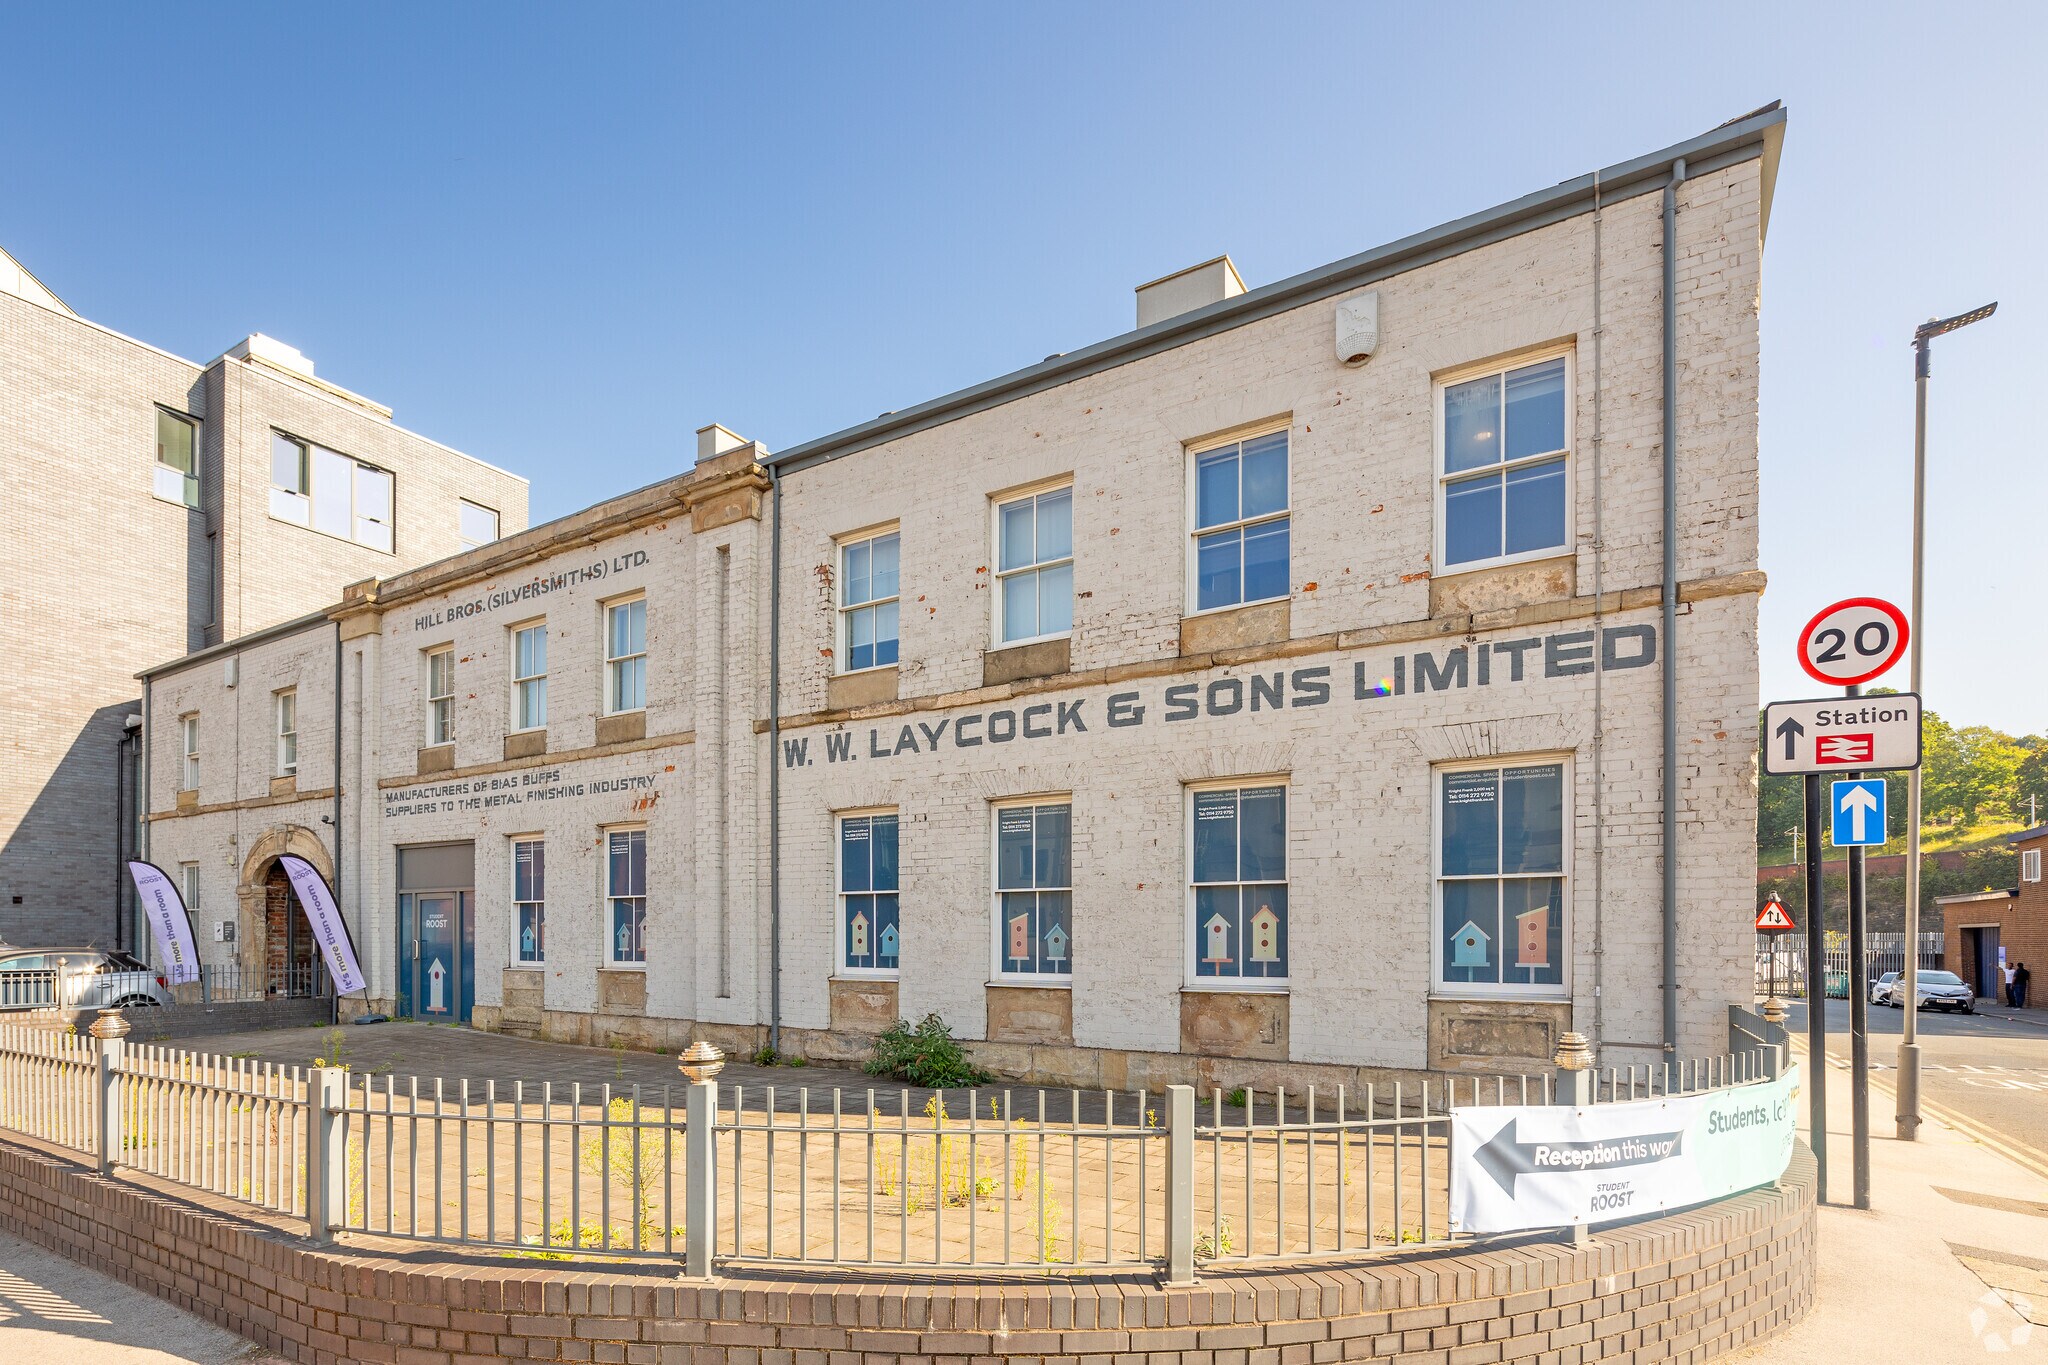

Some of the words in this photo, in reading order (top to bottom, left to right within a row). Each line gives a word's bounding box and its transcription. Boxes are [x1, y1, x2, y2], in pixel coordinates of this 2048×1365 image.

[415, 613, 443, 631] HILL
[447, 599, 485, 622] BROS.
[488, 560, 608, 611] (SILVERSMITHS)
[613, 550, 650, 573] LTD.
[1814, 621, 1890, 664] 20
[783, 737, 813, 767] W.
[826, 732, 857, 762] W.
[870, 699, 1088, 758] LAYCOCK
[1107, 691, 1145, 728] &
[1165, 666, 1330, 721] SONS
[1354, 624, 1656, 700] LIMITED
[1815, 706, 1908, 727] Station
[386, 783, 469, 803] MANUFACTURERS
[473, 781, 487, 791] OF
[491, 777, 518, 790] BIAS
[523, 770, 560, 786] BUFFS
[386, 803, 437, 817] SUPPLIERS
[441, 801, 454, 812] TO
[458, 798, 480, 810] THE
[485, 793, 522, 807] METAL
[527, 785, 584, 802] FINISHING
[590, 775, 656, 794] INDUSTRY
[154, 889, 168, 912] room
[308, 885, 322, 911] room
[164, 920, 176, 940] than
[322, 920, 336, 945] than
[425, 919, 448, 928] ROOST
[171, 941, 182, 963] more
[332, 945, 347, 972] more
[343, 972, 353, 989] It's
[1708, 1105, 1769, 1134] Students,
[1535, 1143, 1625, 1169] Reception
[1622, 1138, 1646, 1160] this
[1649, 1139, 1676, 1157] way
[1596, 1181, 1630, 1192] STUDENT
[1590, 1190, 1634, 1212] ROOST
